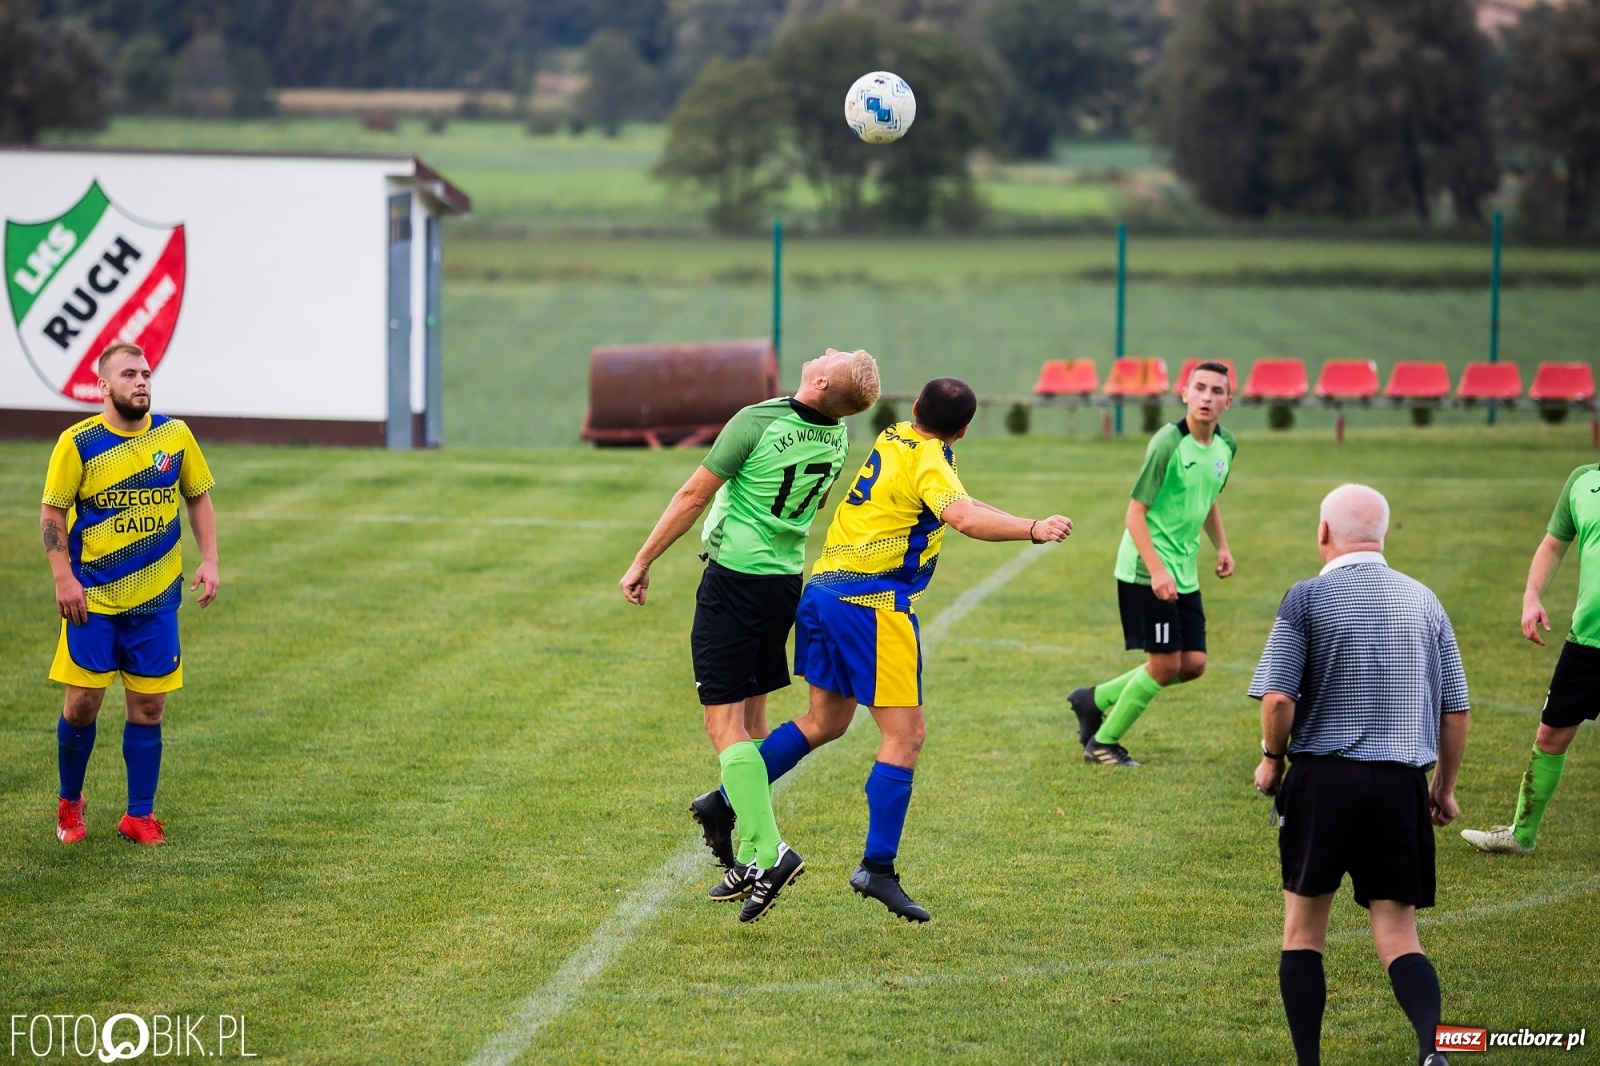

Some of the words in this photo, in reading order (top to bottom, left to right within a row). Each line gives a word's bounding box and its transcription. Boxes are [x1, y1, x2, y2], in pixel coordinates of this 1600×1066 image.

[13, 222, 78, 296] LKS
[43, 236, 142, 350] RUCH
[774, 432, 794, 453] LKS
[770, 462, 833, 519] 17
[114, 515, 165, 534] GAIDA
[1155, 622, 1170, 644] 11
